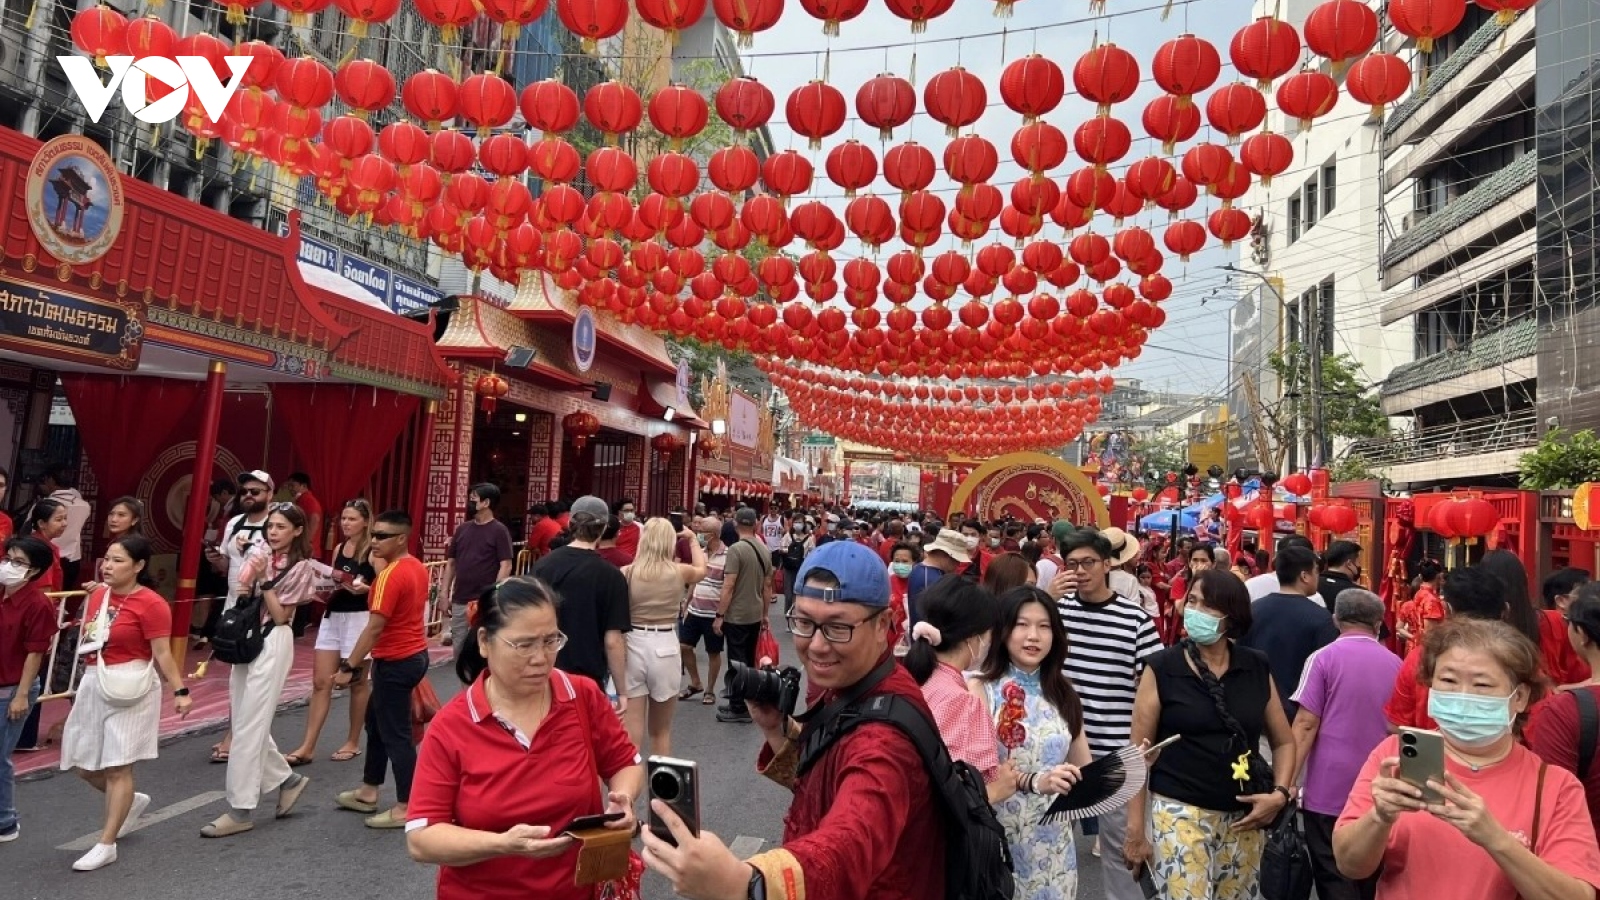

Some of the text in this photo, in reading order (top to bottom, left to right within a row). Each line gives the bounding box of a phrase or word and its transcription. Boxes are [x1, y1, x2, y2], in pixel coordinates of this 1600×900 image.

[344, 260, 385, 291] จัดยาโดย
[28, 324, 91, 345] เขตสัมพันธวงศ์
